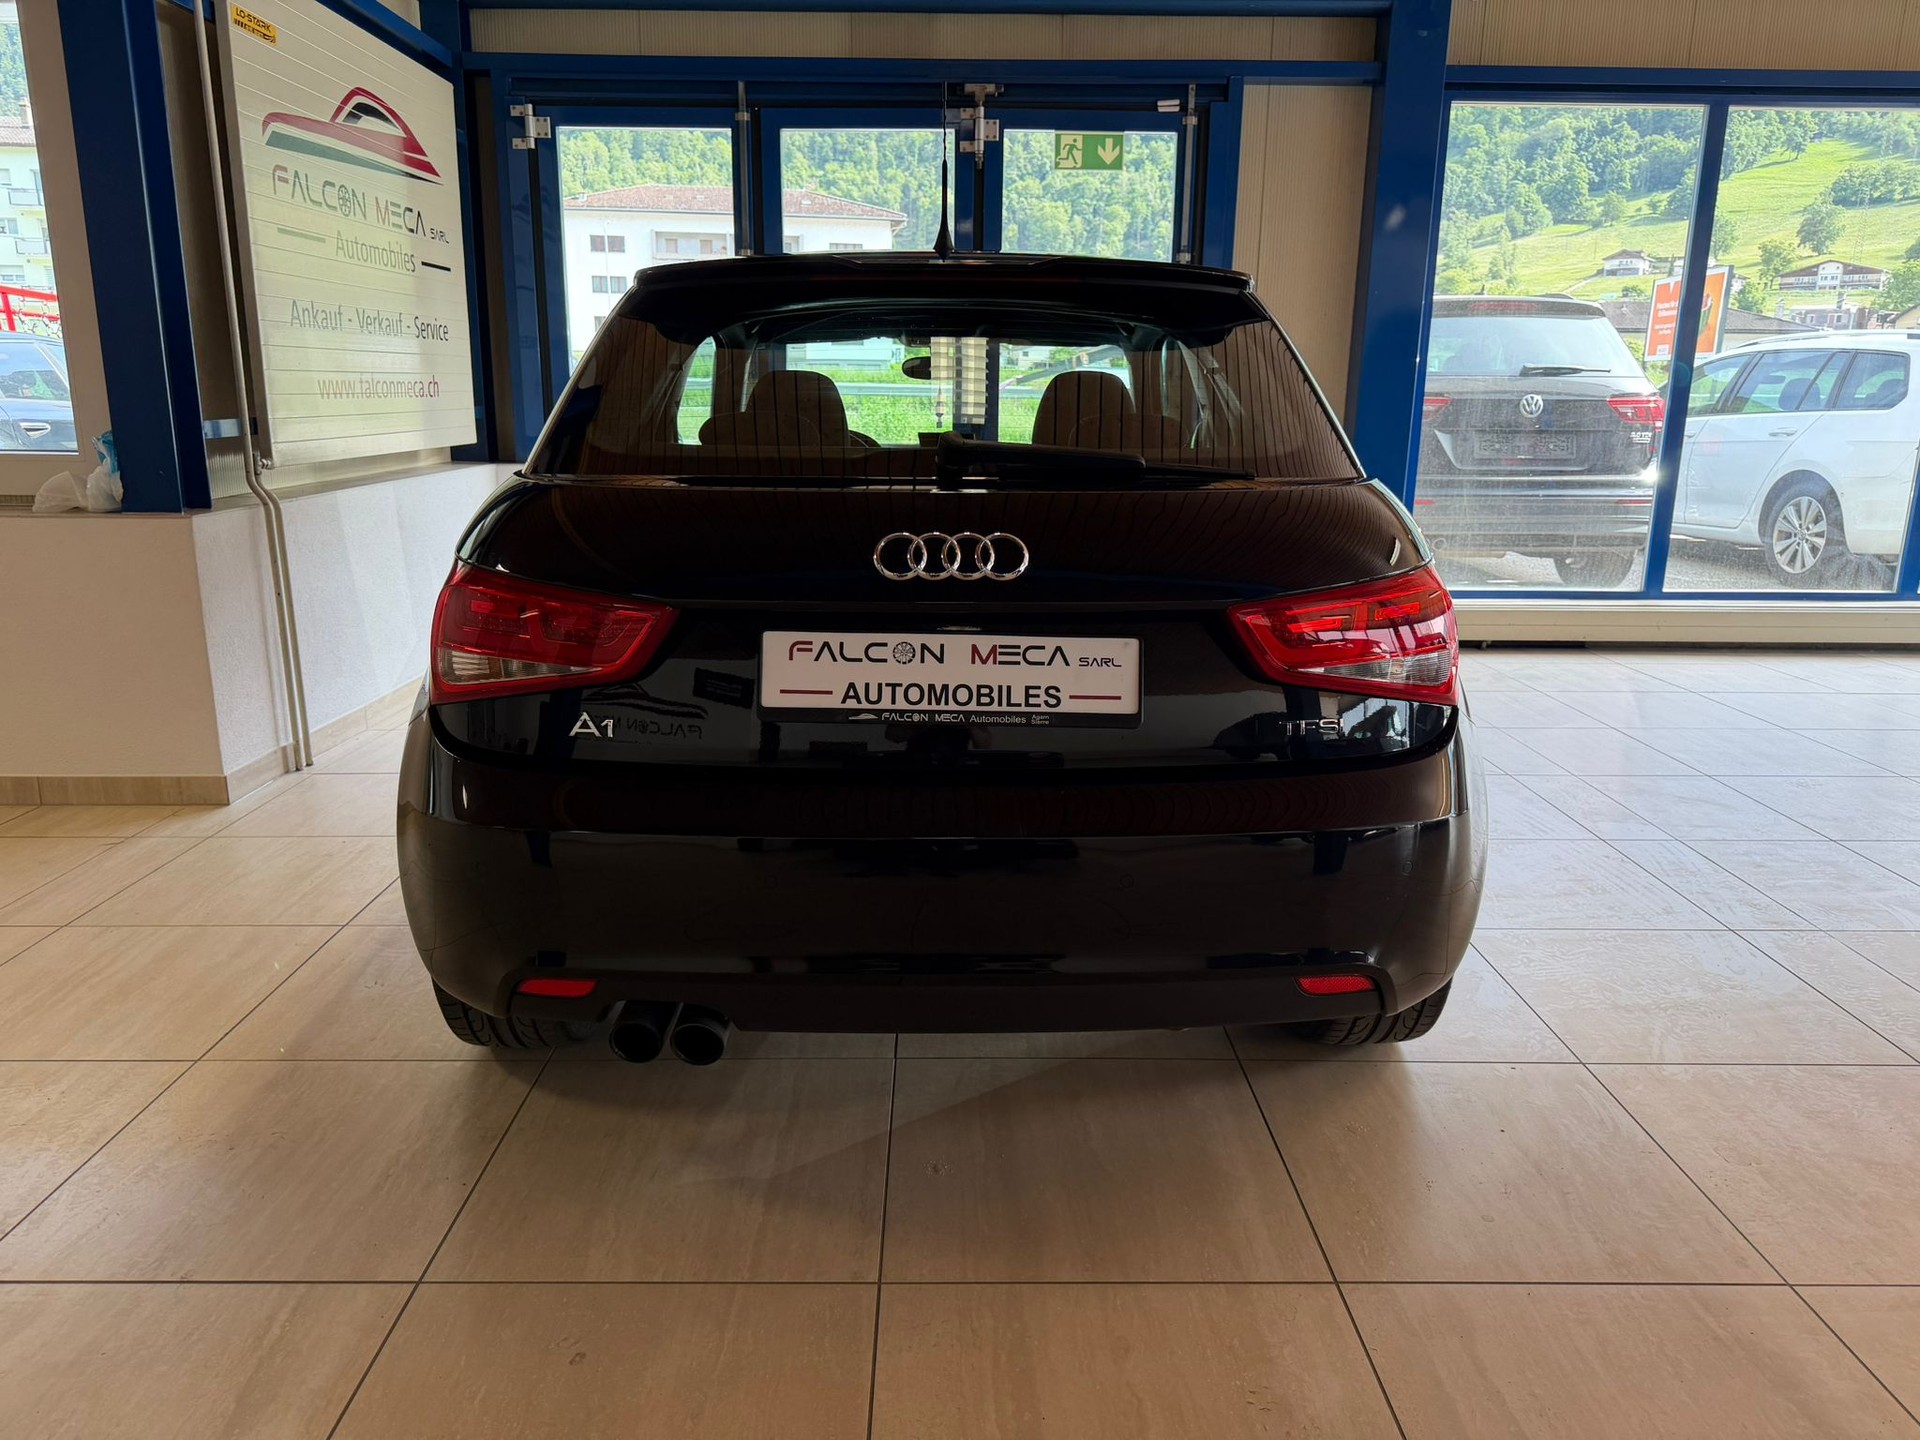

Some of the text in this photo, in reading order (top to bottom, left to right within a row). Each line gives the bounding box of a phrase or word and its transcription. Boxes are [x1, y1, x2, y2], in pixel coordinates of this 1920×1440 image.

[235, 7, 272, 33] LO-STARK
[272, 164, 449, 244] FALCON MECA SARL
[335, 230, 416, 272] Automobiles
[290, 299, 344, 331] Ankauf
[355, 308, 404, 336] Verkauf
[414, 316, 449, 342] Service
[318, 373, 440, 400] www.falconmeca.ch
[788, 641, 1122, 668] FALCON MECA SARL
[841, 682, 1062, 709] AUTOMOBILES
[568, 711, 614, 738] A1
[881, 712, 1027, 724] FALCON MECA Automobiles
[1279, 718, 1345, 736] TFSI
